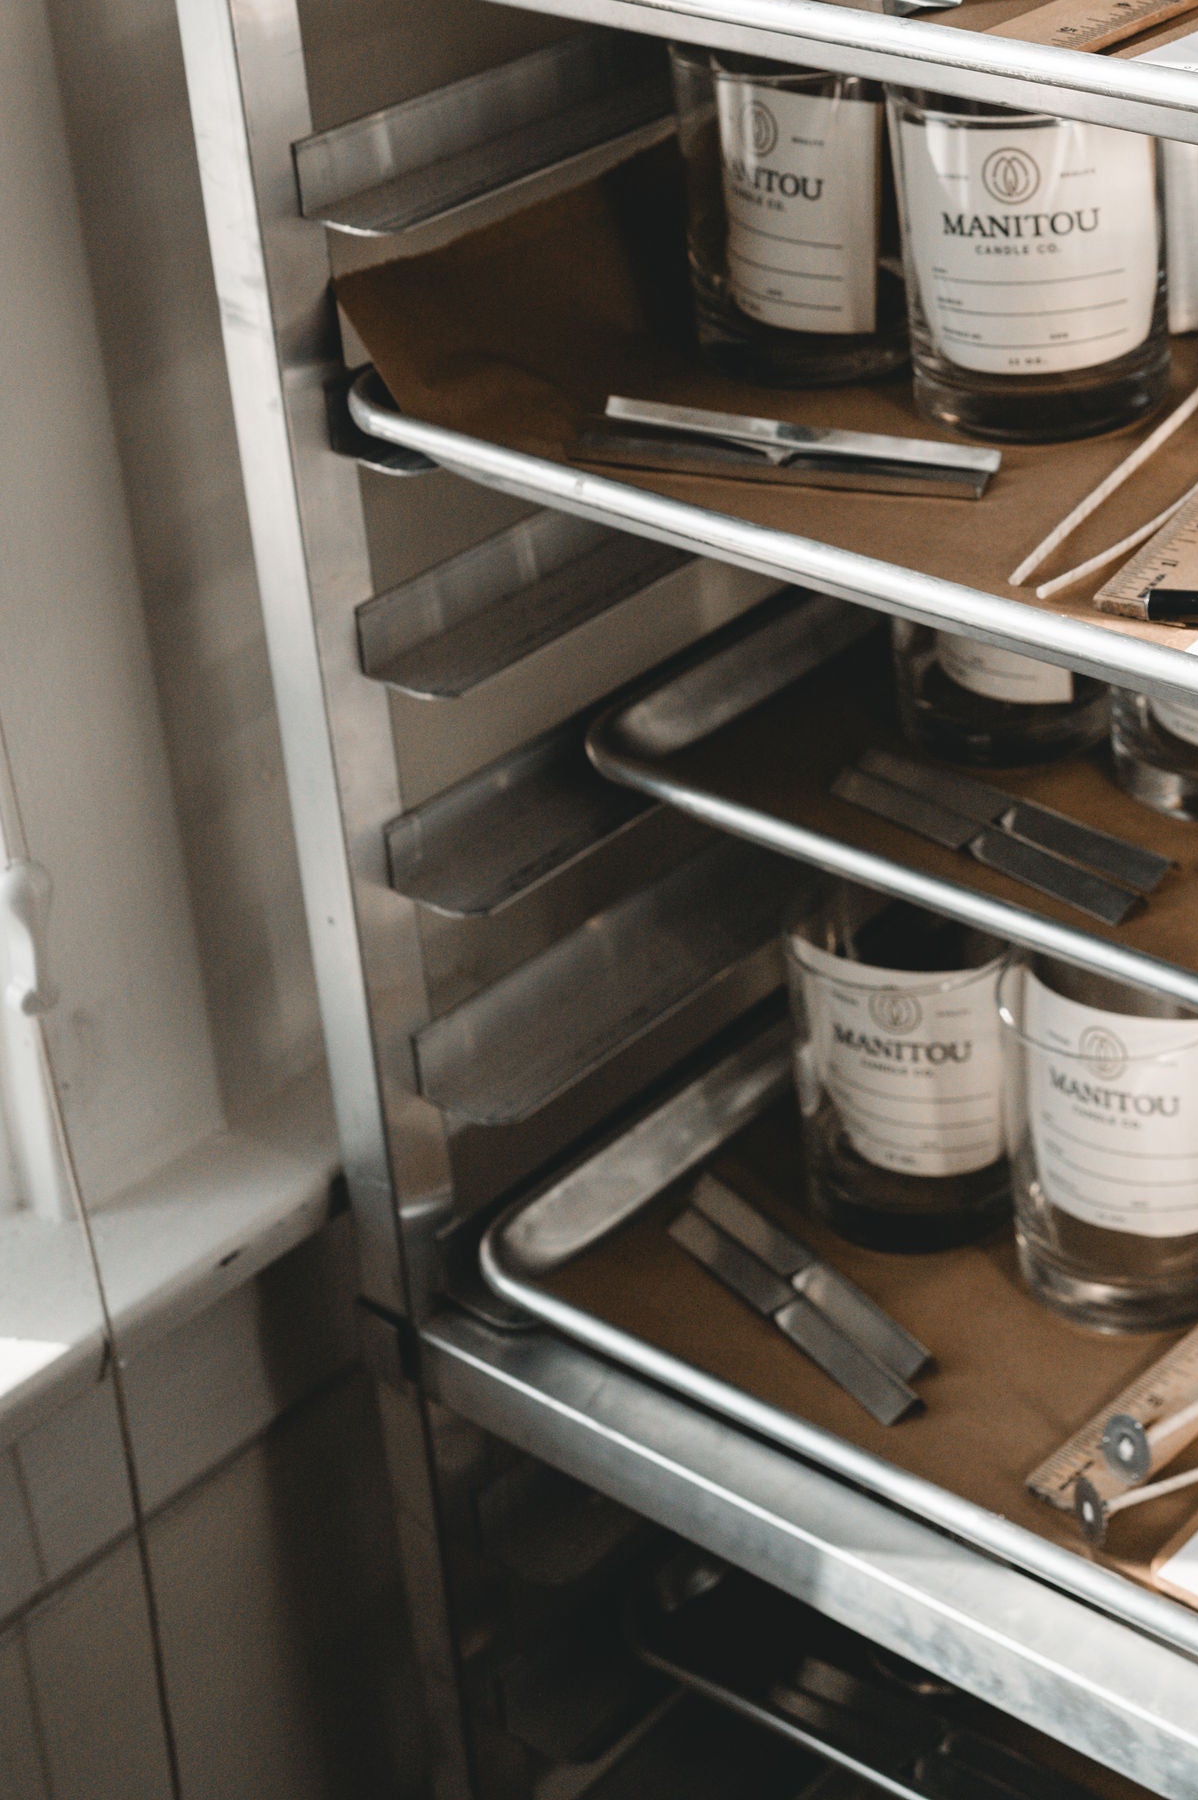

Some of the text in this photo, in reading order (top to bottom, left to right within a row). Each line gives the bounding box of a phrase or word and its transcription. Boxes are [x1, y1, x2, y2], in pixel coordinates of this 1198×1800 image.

[941, 207, 1100, 239] MANITOU
[832, 1022, 972, 1065] MANITOU
[1049, 1064, 1181, 1117] MANITOU
